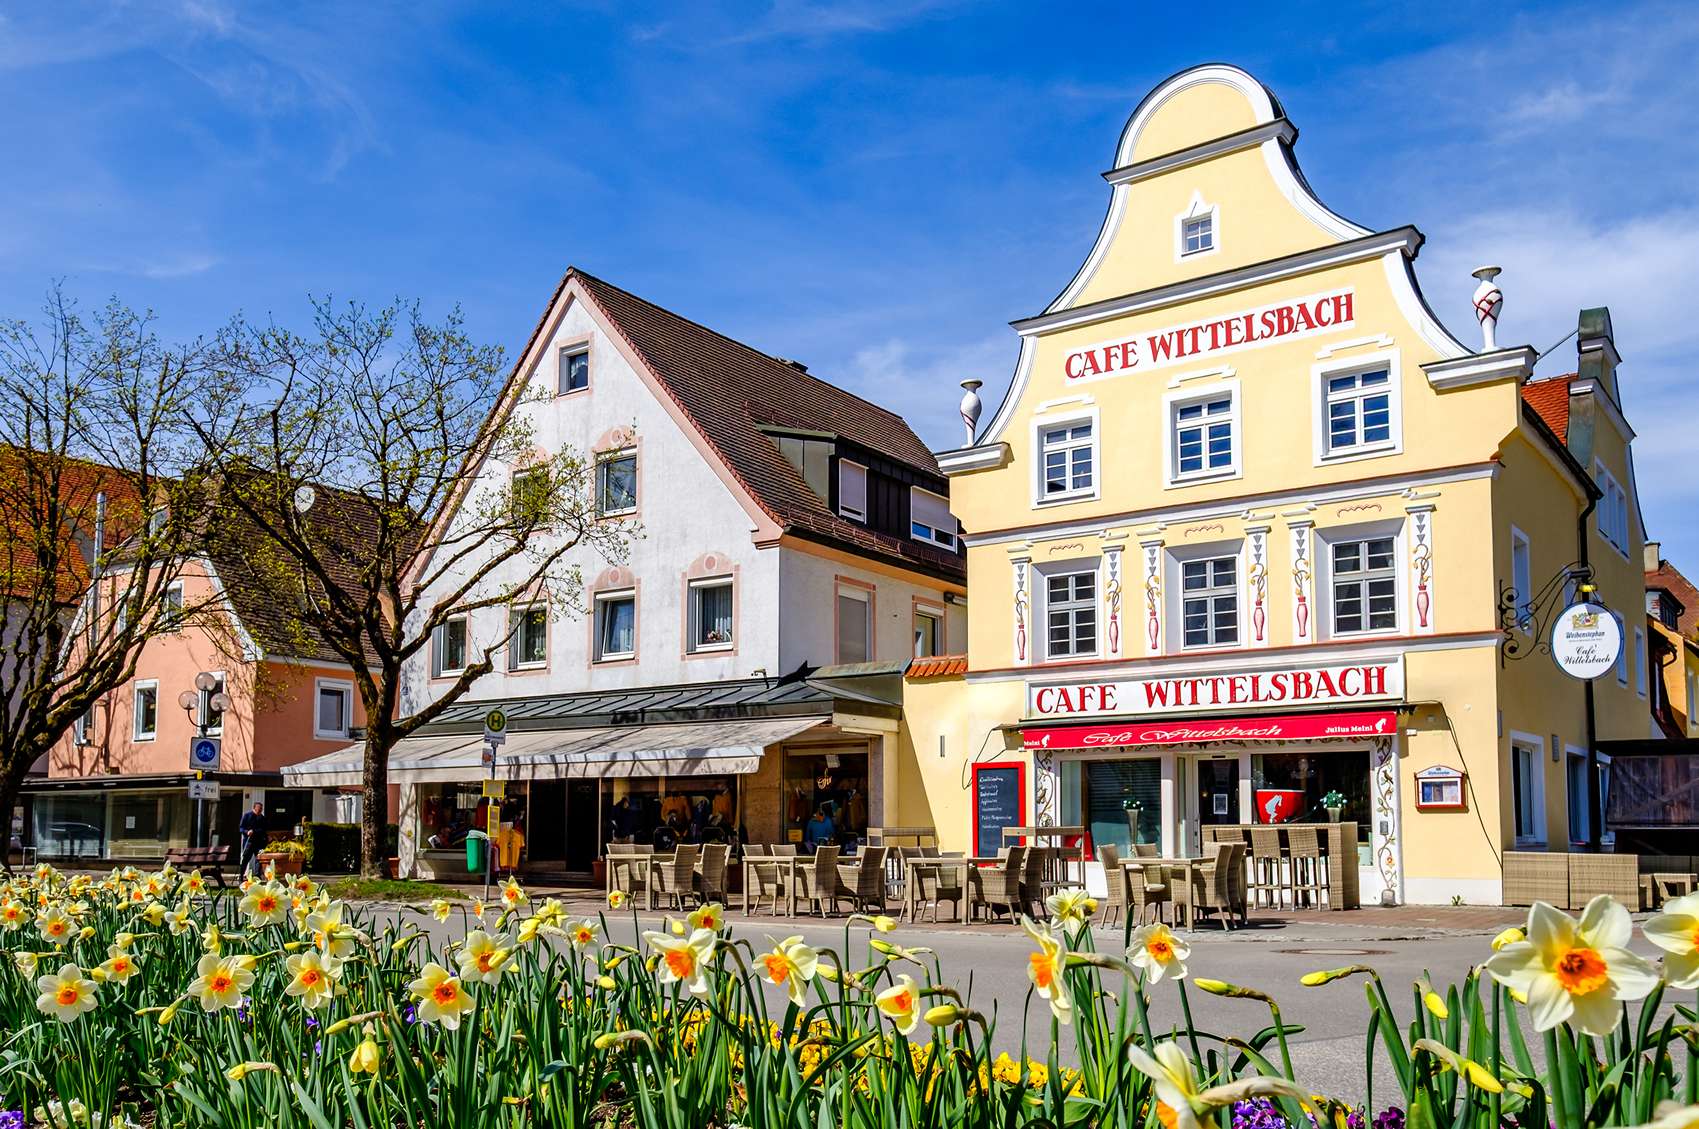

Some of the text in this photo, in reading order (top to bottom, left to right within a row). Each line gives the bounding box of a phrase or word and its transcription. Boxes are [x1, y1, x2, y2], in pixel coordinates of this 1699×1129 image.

[1065, 293, 1354, 379] CAFE WITTELSBACH
[1564, 653, 1611, 665] Wittelsbach
[1036, 666, 1388, 714] CAFE WITTELSBACH
[491, 714, 501, 728] H
[1139, 724, 1282, 741] Wittelsbach
[1325, 724, 1373, 734] Julius Meinl
